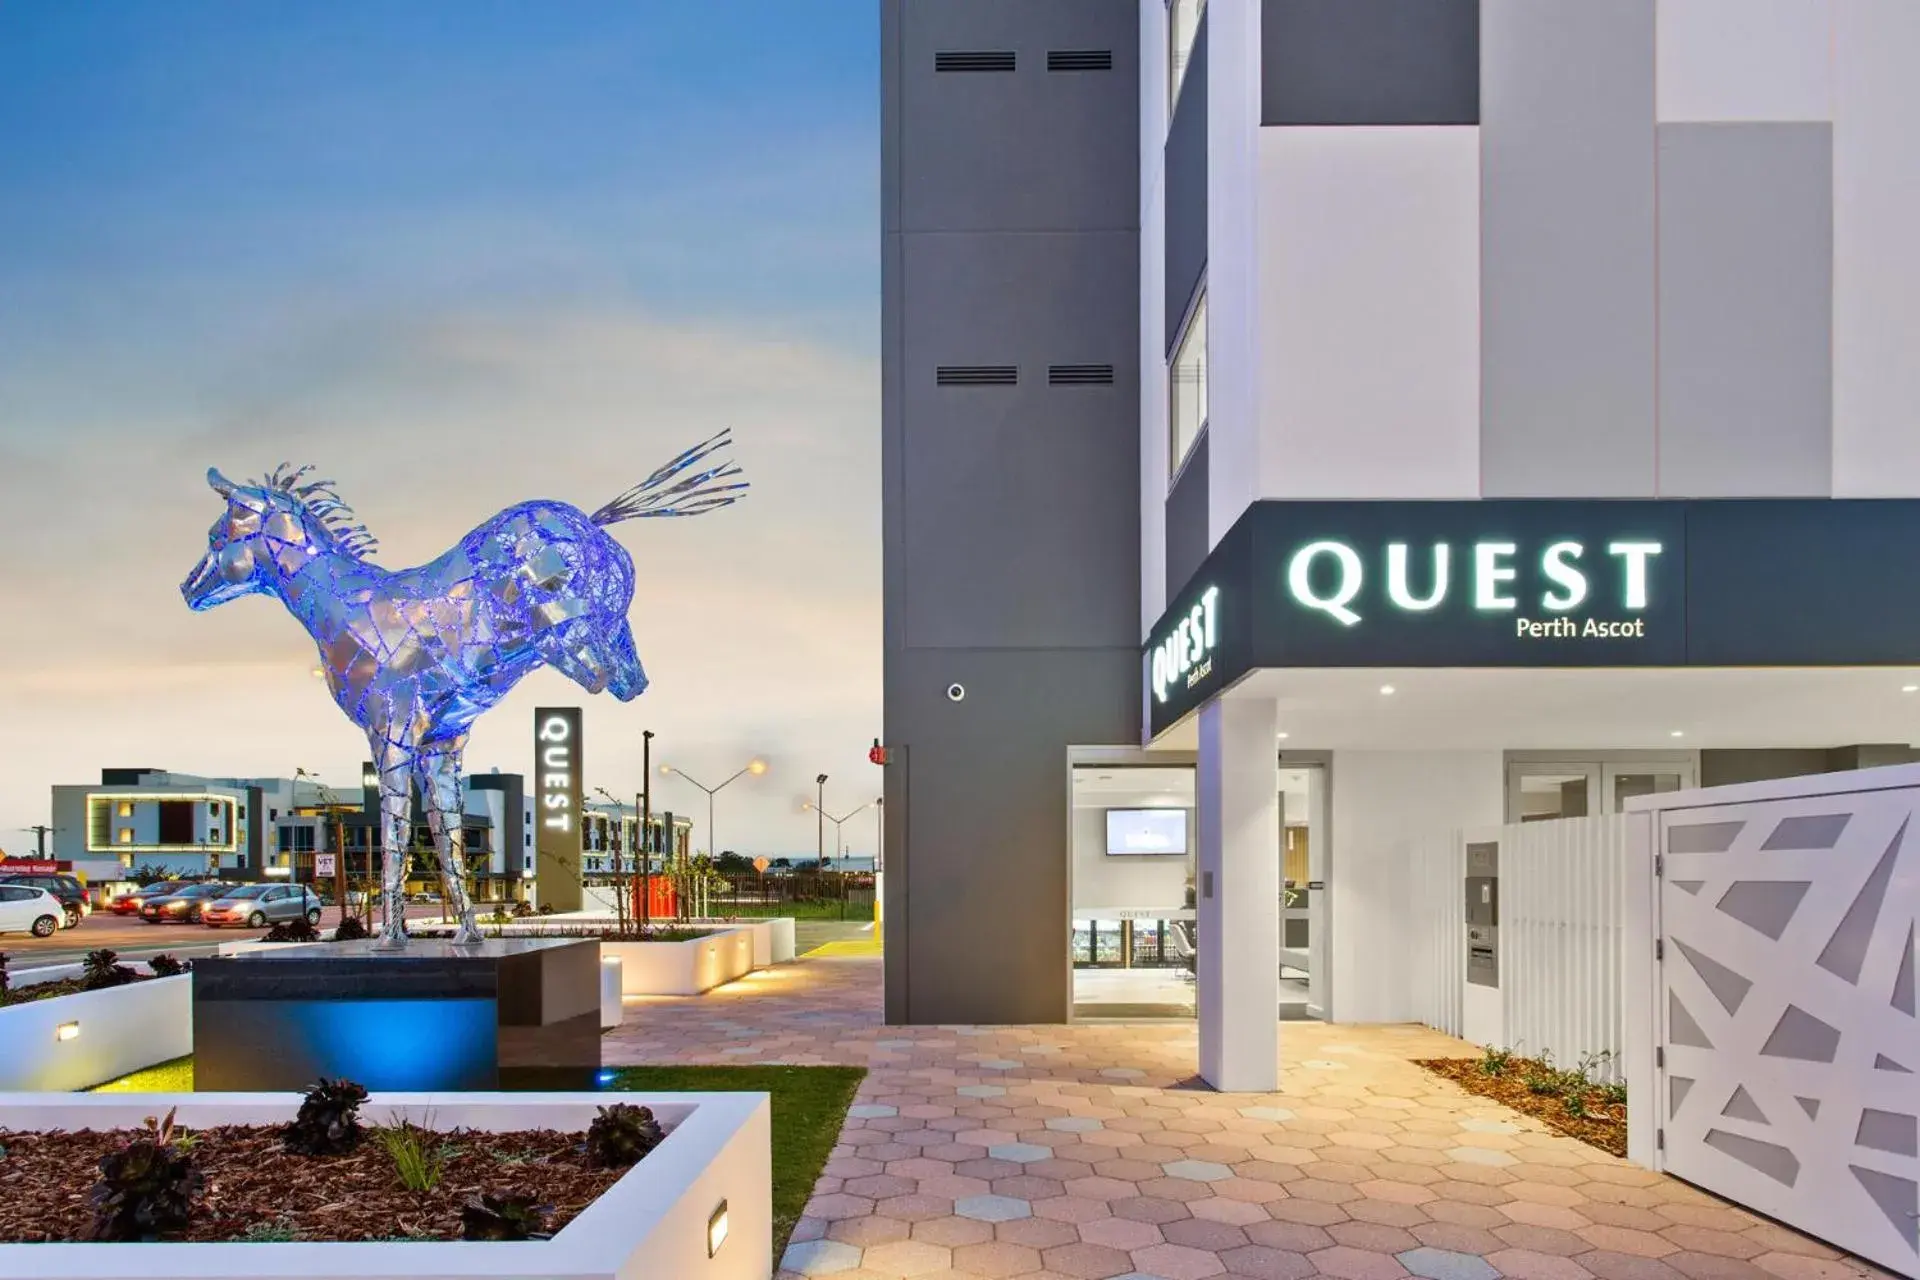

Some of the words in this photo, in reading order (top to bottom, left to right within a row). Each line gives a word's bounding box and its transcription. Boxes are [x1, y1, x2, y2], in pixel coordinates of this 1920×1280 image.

[1288, 541, 1663, 626] QUEST
[1152, 586, 1219, 702] QUEST
[1517, 617, 1577, 637] Perth
[1582, 618, 1645, 637] Ascot
[539, 717, 569, 832] QUEST
[318, 857, 333, 865] VET
